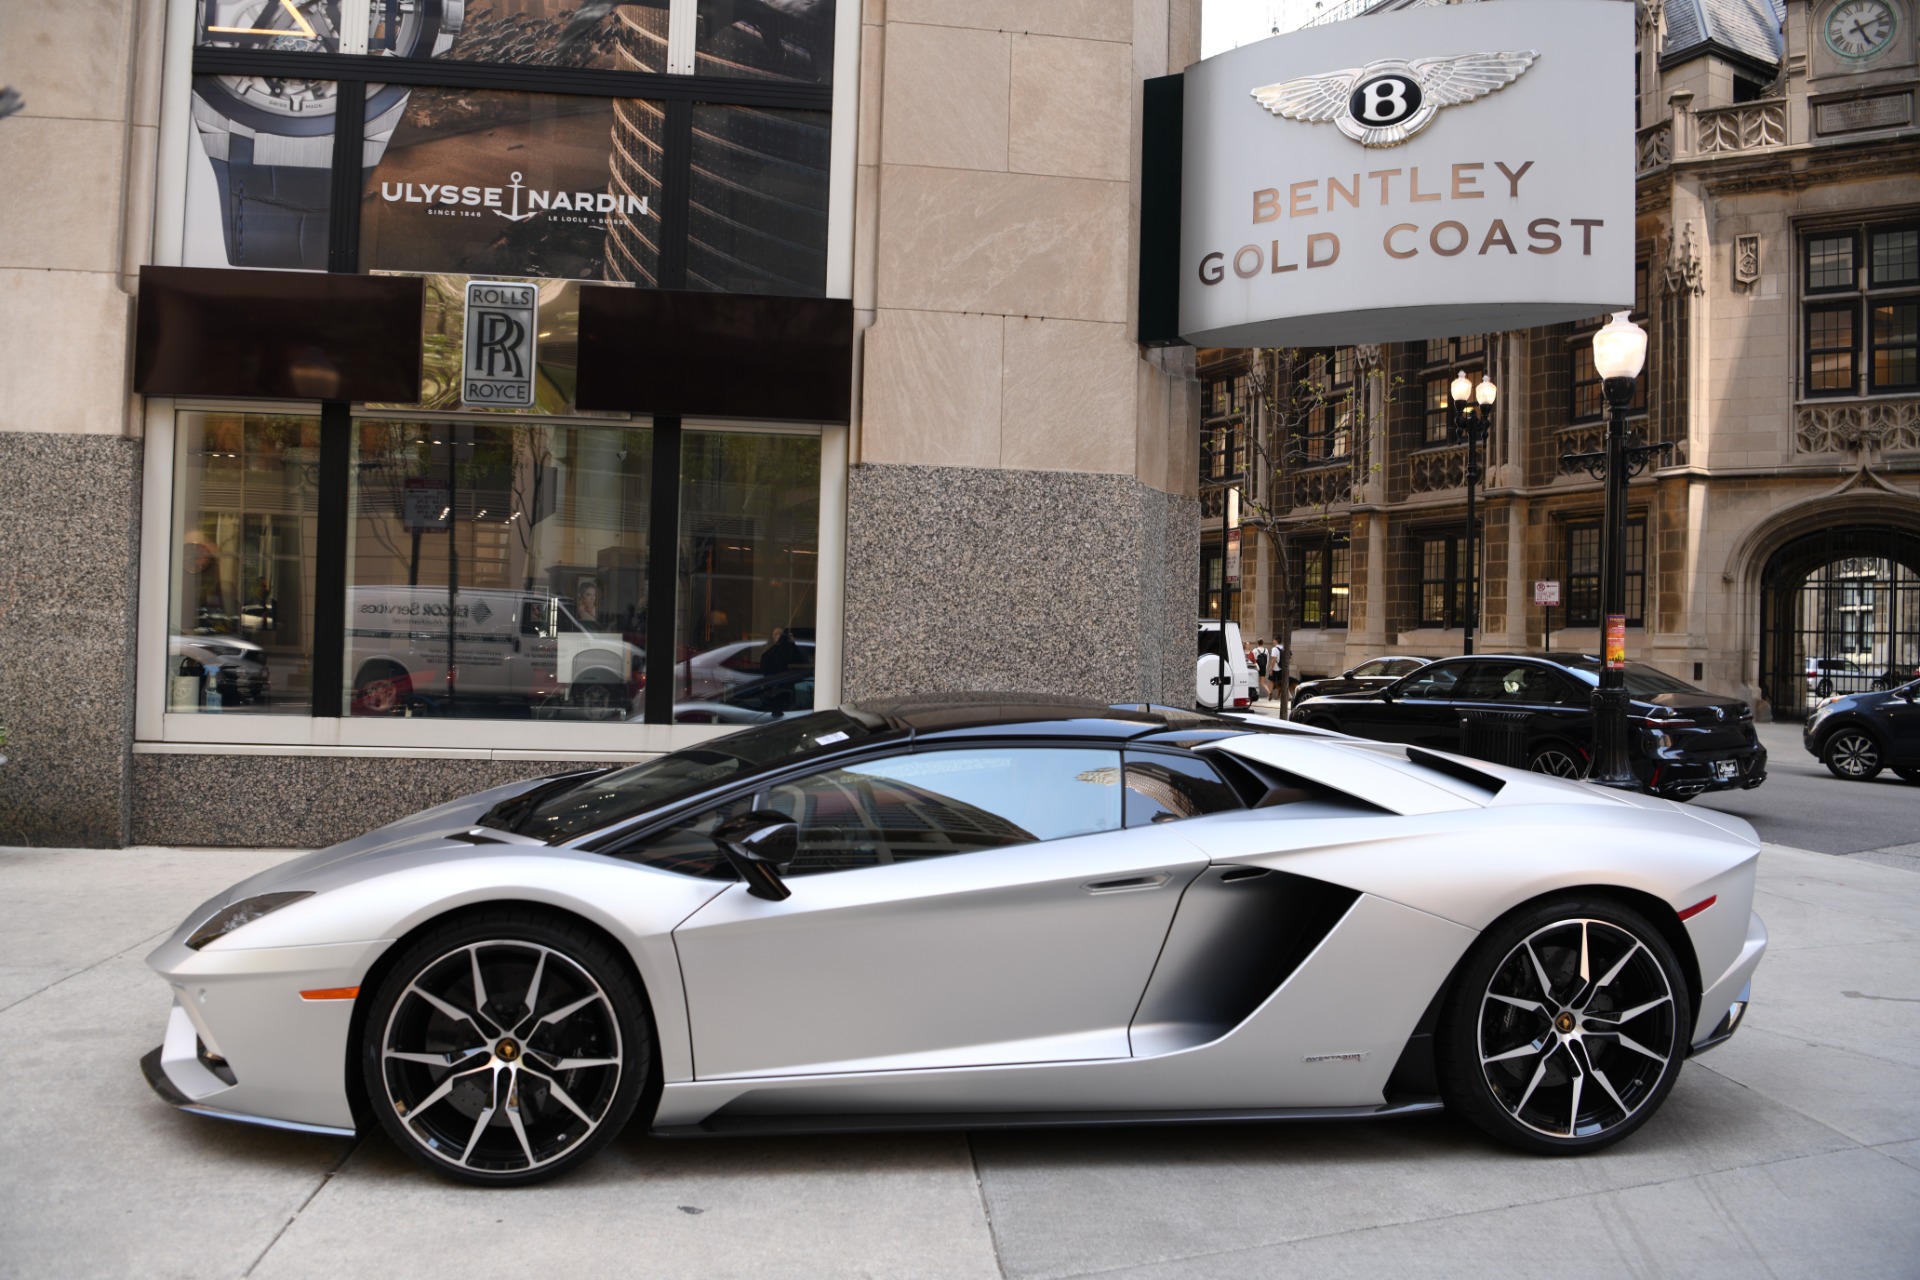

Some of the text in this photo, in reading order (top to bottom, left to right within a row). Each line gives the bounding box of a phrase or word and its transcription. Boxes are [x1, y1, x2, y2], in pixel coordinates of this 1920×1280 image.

[381, 182, 649, 215] ULYSSE NARDIN
[1252, 160, 1535, 224] BENTLEY
[599, 218, 629, 226] SUISSE
[1198, 217, 1605, 286] GOLD COAST
[473, 289, 530, 305] ROLLS
[469, 383, 526, 400] ROYCE
